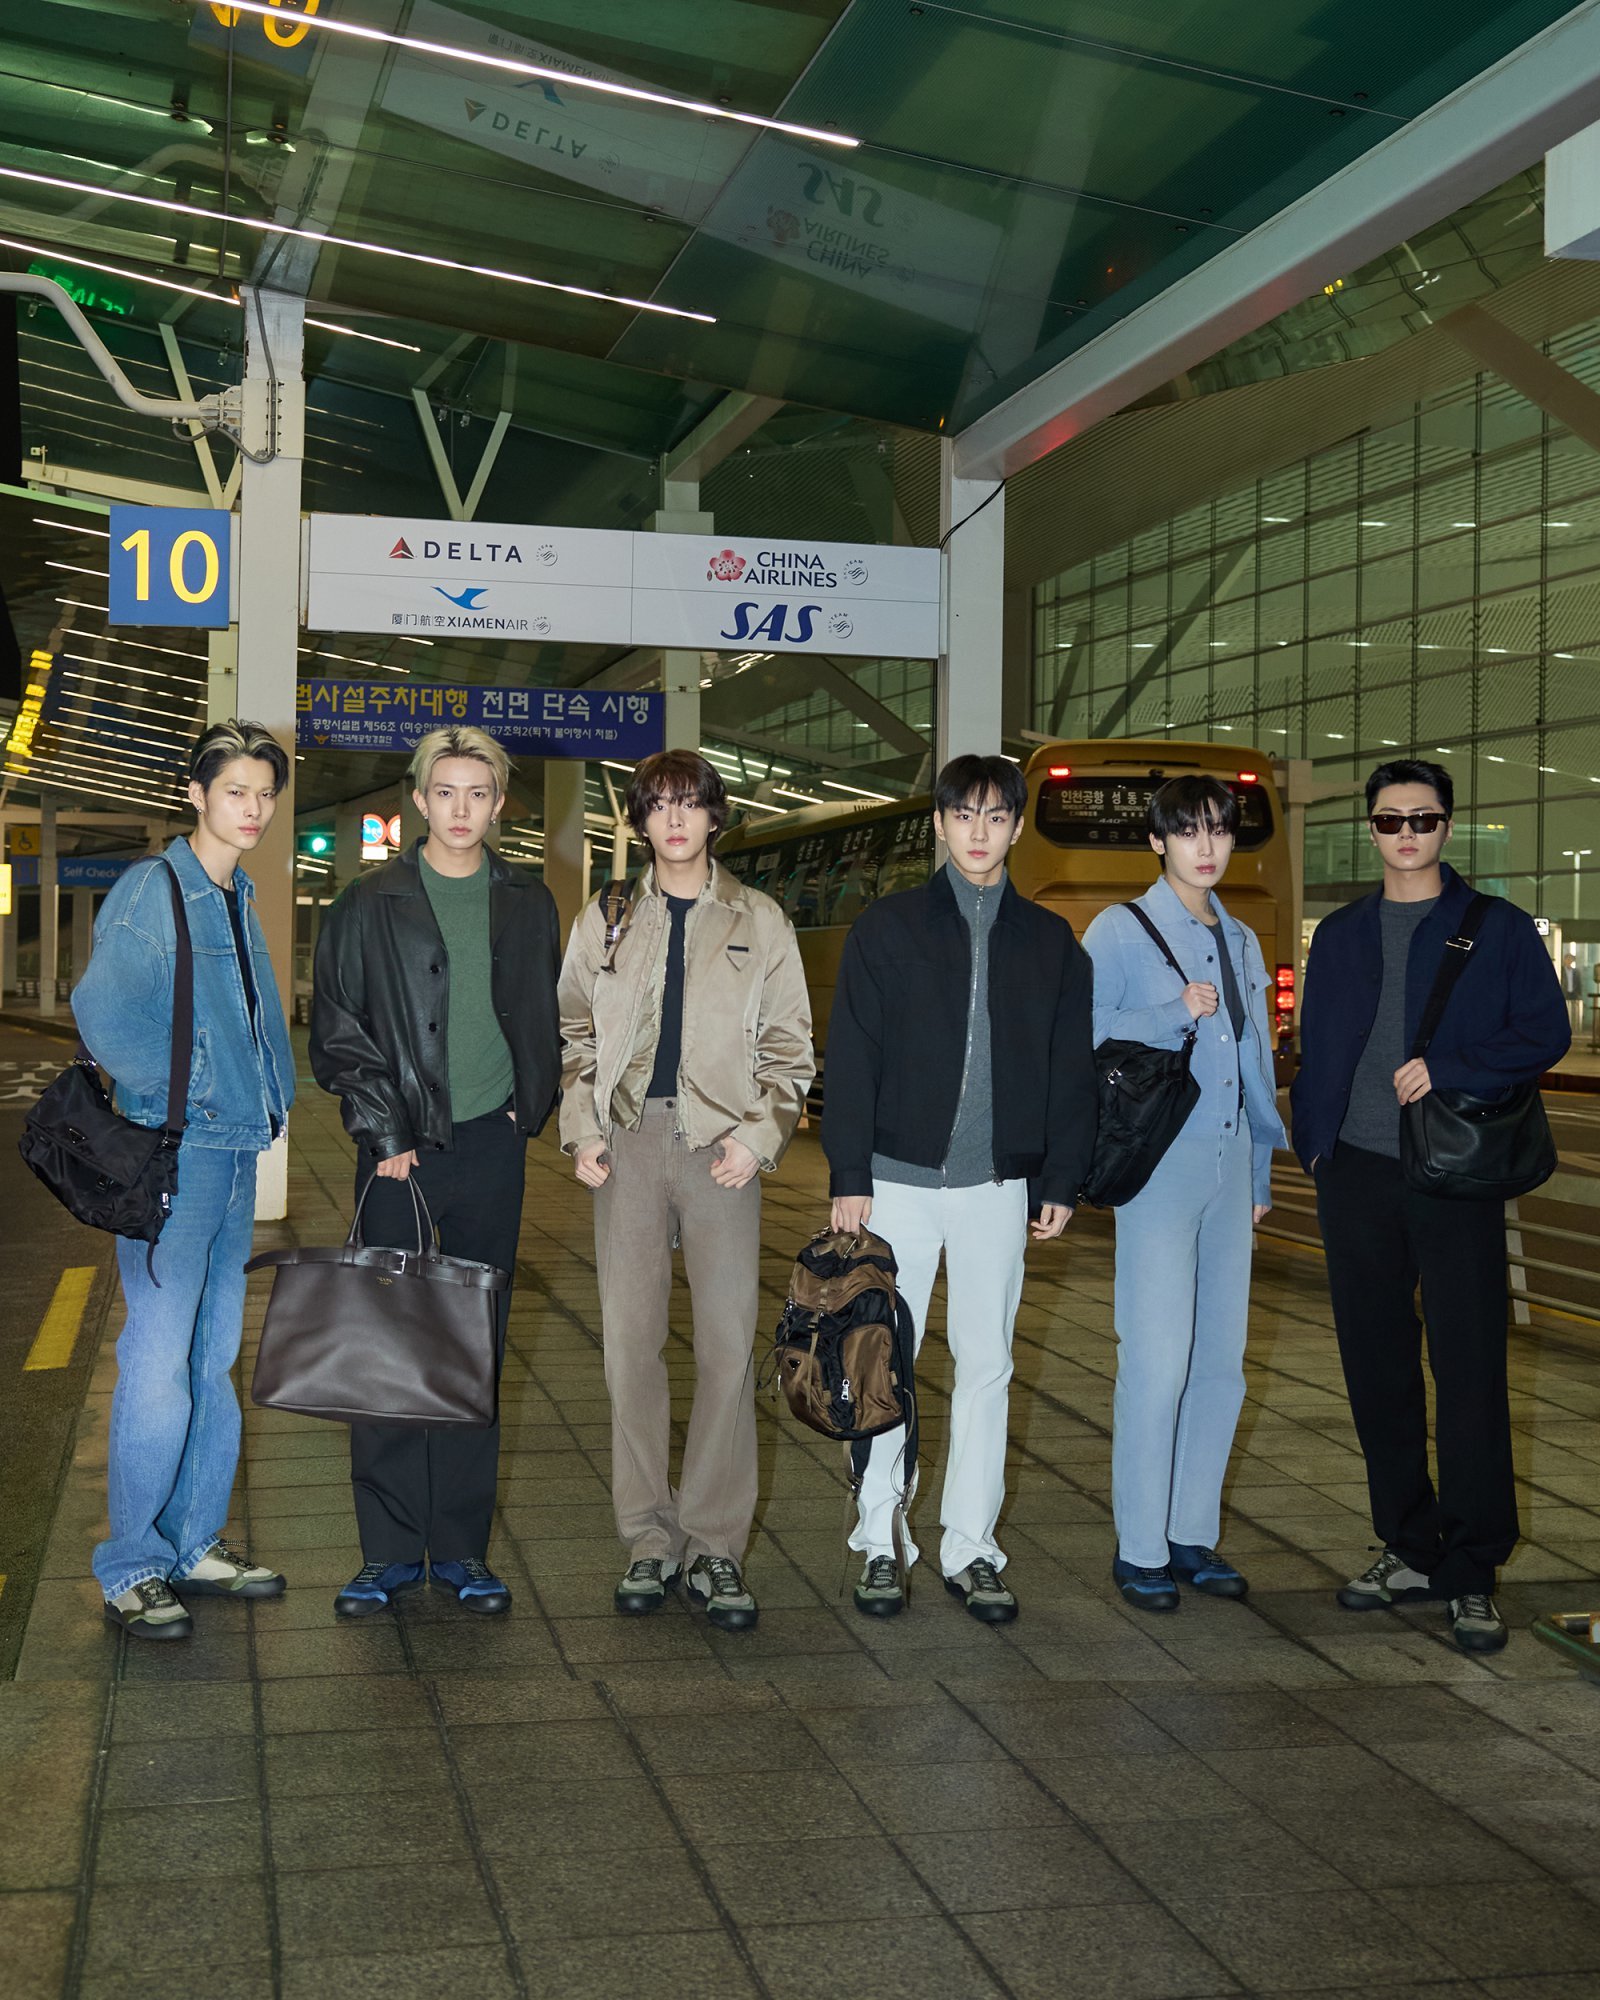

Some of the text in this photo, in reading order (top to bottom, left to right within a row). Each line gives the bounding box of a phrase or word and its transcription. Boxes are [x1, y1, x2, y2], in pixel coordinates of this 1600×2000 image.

[424, 540, 522, 563] DELTA
[756, 551, 825, 570] CHINA
[121, 529, 219, 604] 10
[744, 568, 838, 588] AIRLINES
[447, 616, 529, 631] XIAMENAIR
[720, 601, 823, 643] SAS
[482, 690, 529, 720] 전면
[543, 693, 591, 722] 단속
[602, 695, 649, 725] 시행
[312, 718, 360, 732] 공항시설법
[363, 720, 397, 733] 제56조
[1061, 790, 1105, 804] 인천공항
[64, 866, 84, 877] Self
